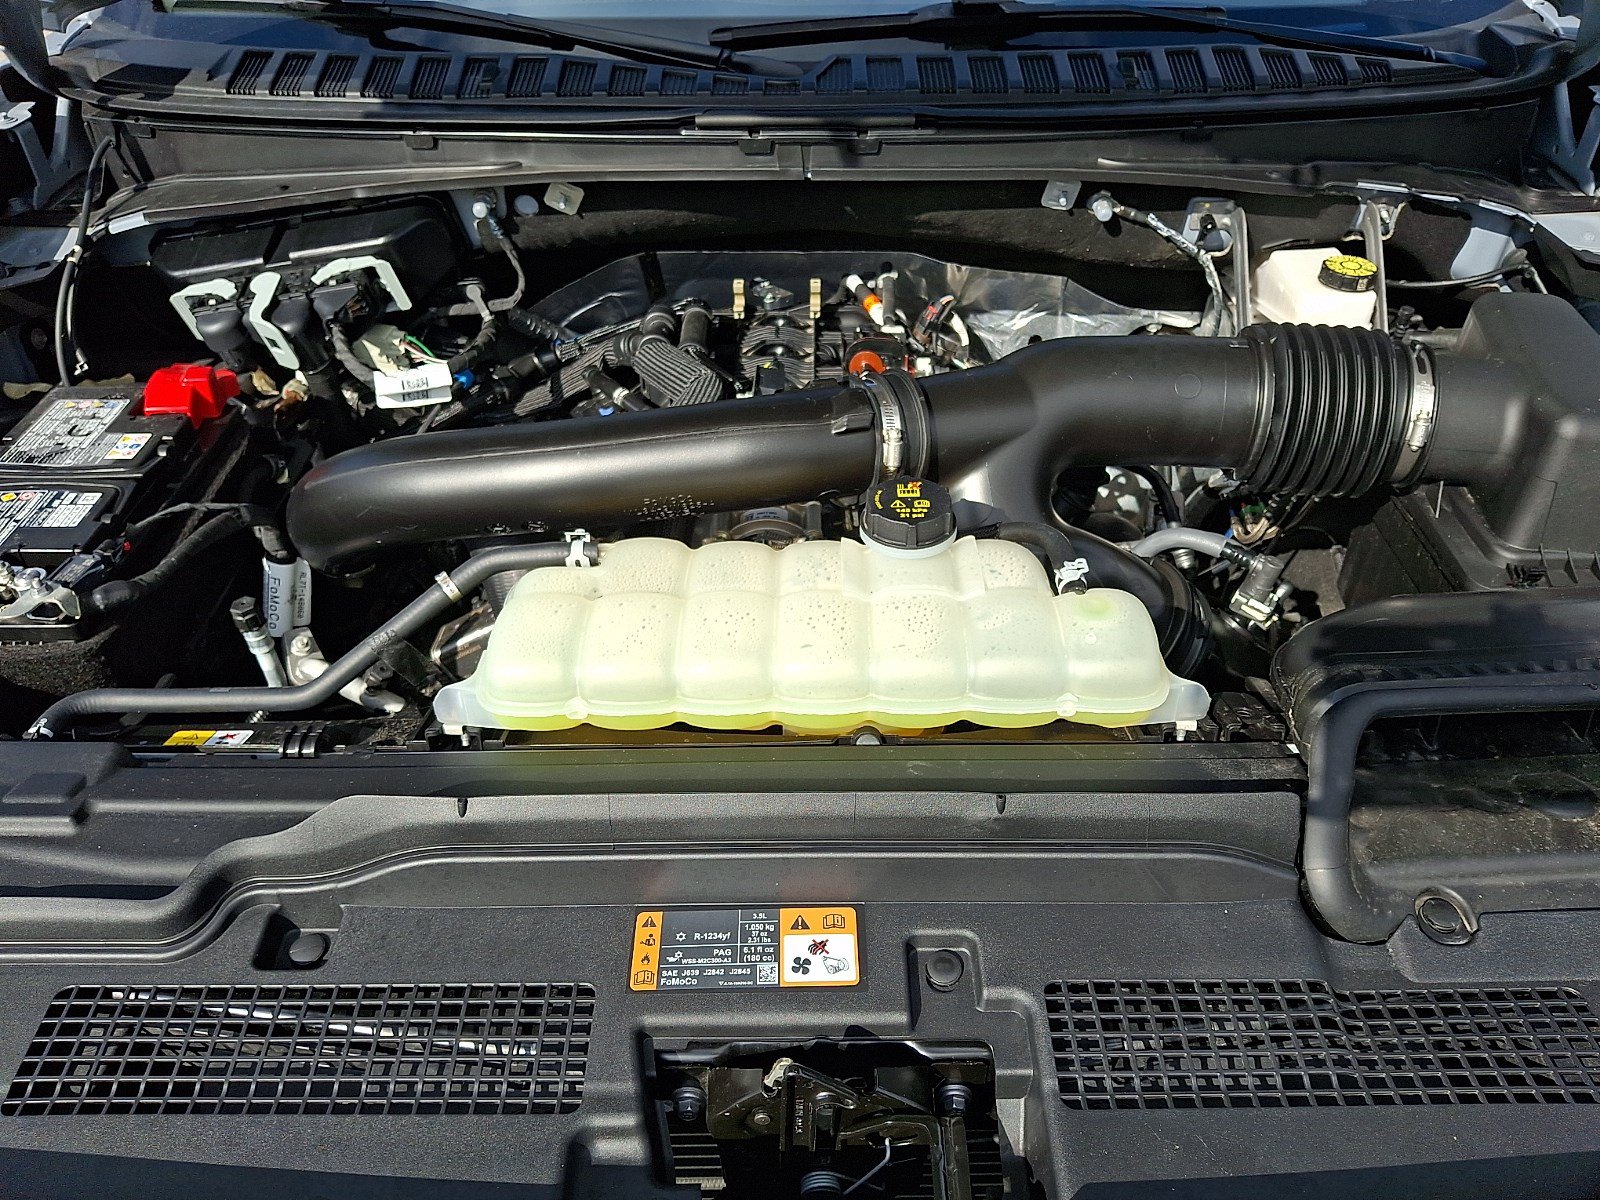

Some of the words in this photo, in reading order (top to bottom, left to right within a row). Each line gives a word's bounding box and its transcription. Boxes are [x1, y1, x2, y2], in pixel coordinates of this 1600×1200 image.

[269, 576, 281, 630] FoMoCo
[765, 924, 774, 932] kg
[694, 932, 731, 941] R-1234yf
[660, 978, 698, 986] FoMoCo
